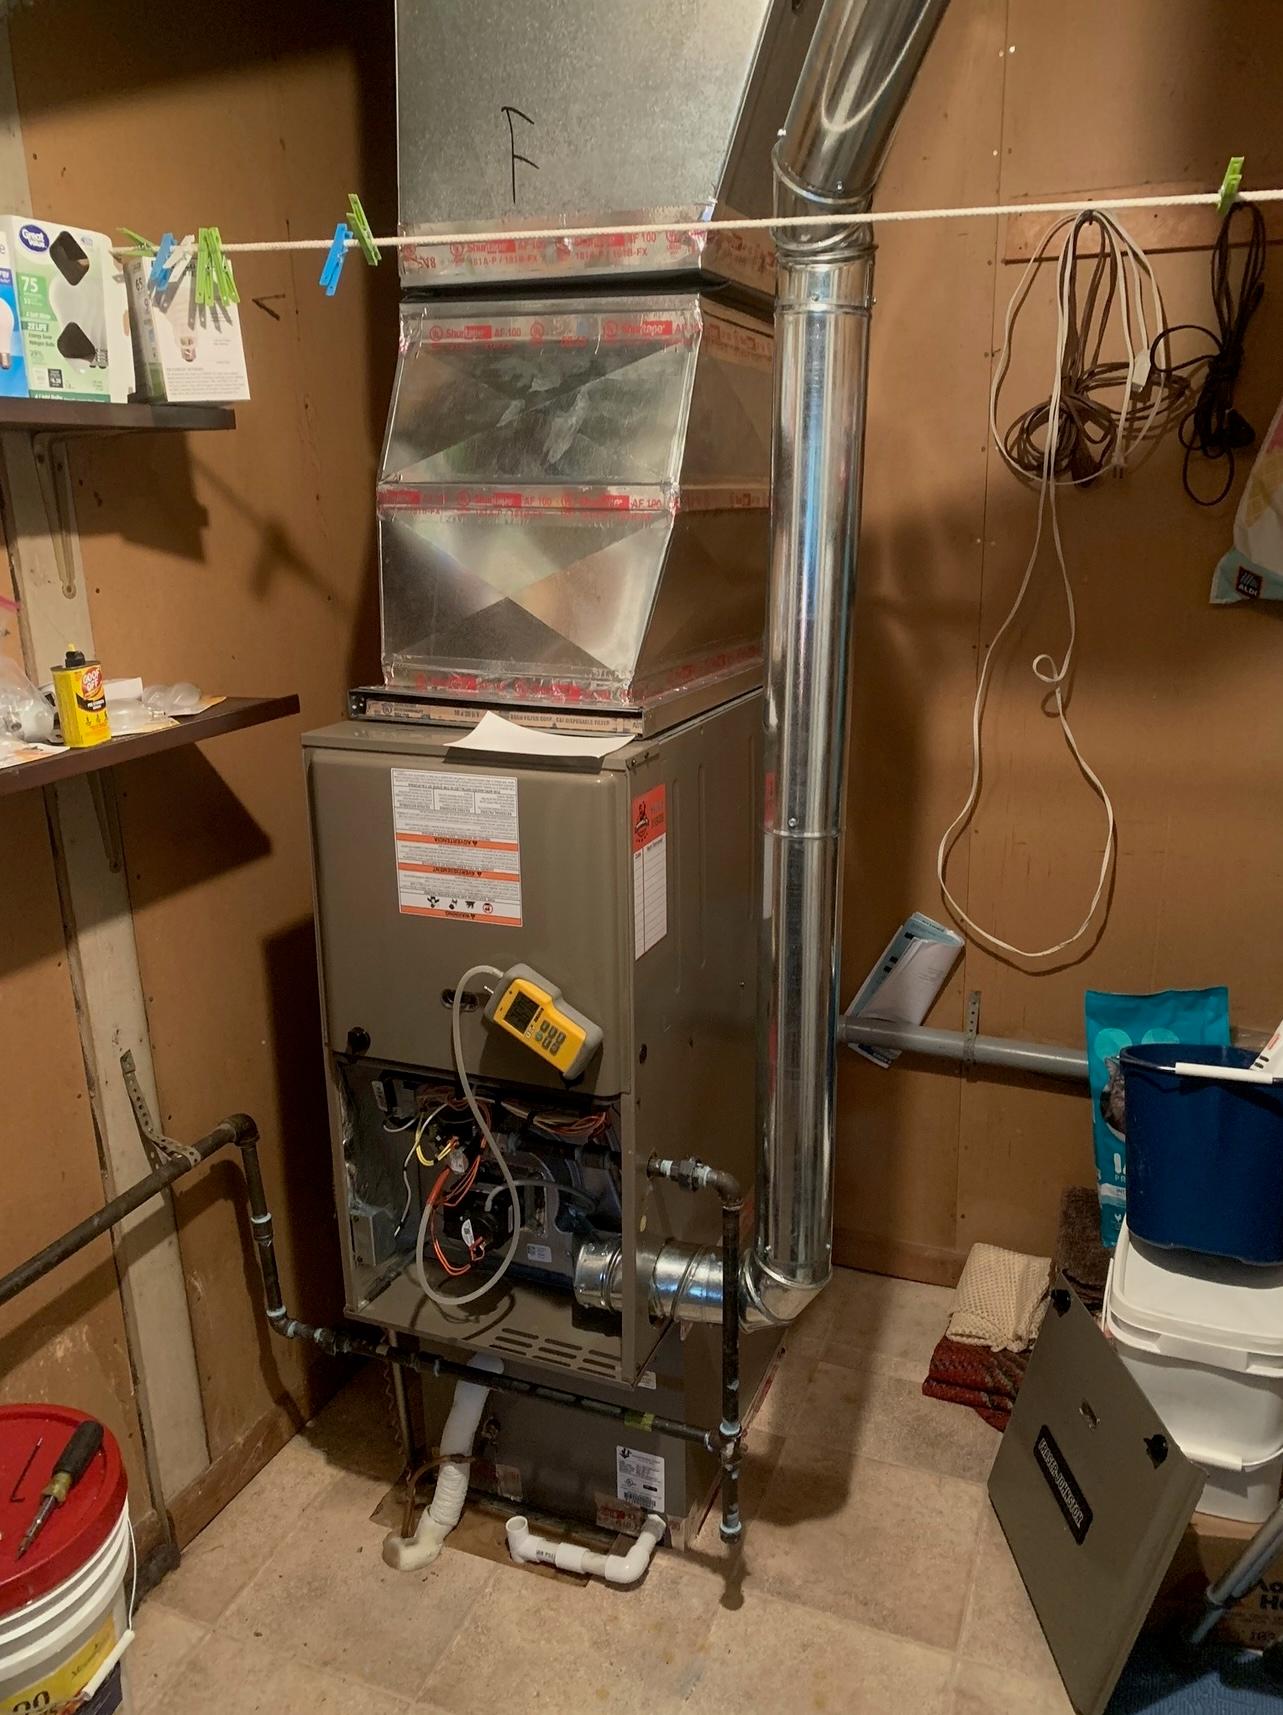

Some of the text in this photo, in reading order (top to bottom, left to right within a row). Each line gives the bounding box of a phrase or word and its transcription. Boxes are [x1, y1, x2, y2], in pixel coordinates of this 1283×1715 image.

[501, 107, 540, 203] F
[22, 229, 45, 243] Great
[21, 275, 38, 293] 75
[83, 667, 100, 684] GOOF
[86, 679, 99, 692] OFF
